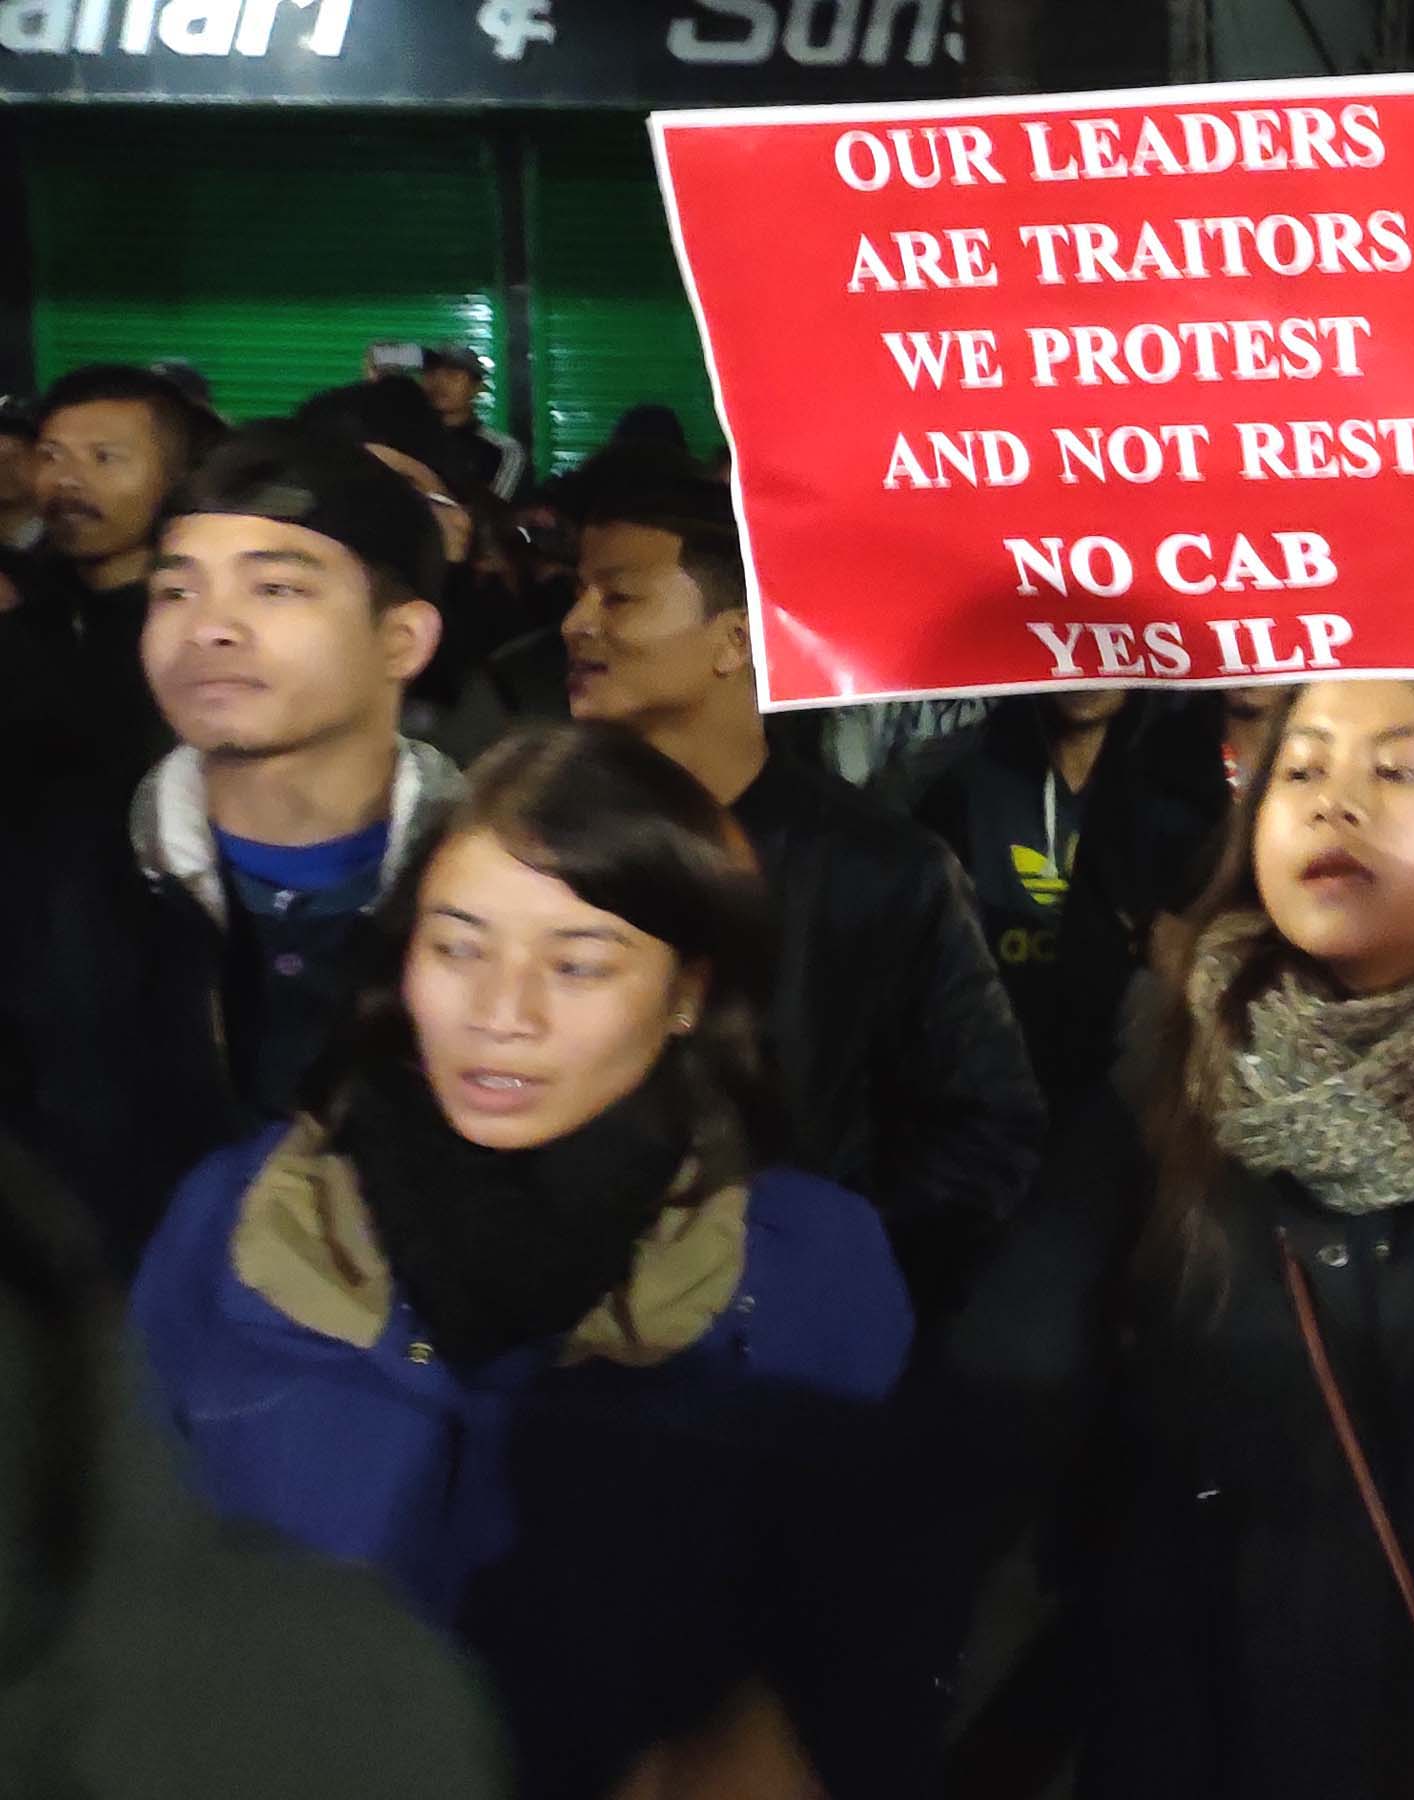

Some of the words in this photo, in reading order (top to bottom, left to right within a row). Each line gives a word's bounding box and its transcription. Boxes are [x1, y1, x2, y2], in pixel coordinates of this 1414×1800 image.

[833, 126, 1006, 192] OUR
[1019, 104, 1386, 182] LEADERS
[847, 228, 999, 293] ARE
[1019, 209, 1413, 285] TRAITORS
[881, 329, 1003, 391] WE
[1027, 316, 1372, 387] PROTEST
[882, 429, 1031, 491] AND
[1052, 423, 1211, 485] NOT
[1003, 535, 1134, 598] NO
[1155, 531, 1339, 596] CAB
[1026, 620, 1192, 678] YES
[1205, 613, 1354, 675] ILP
